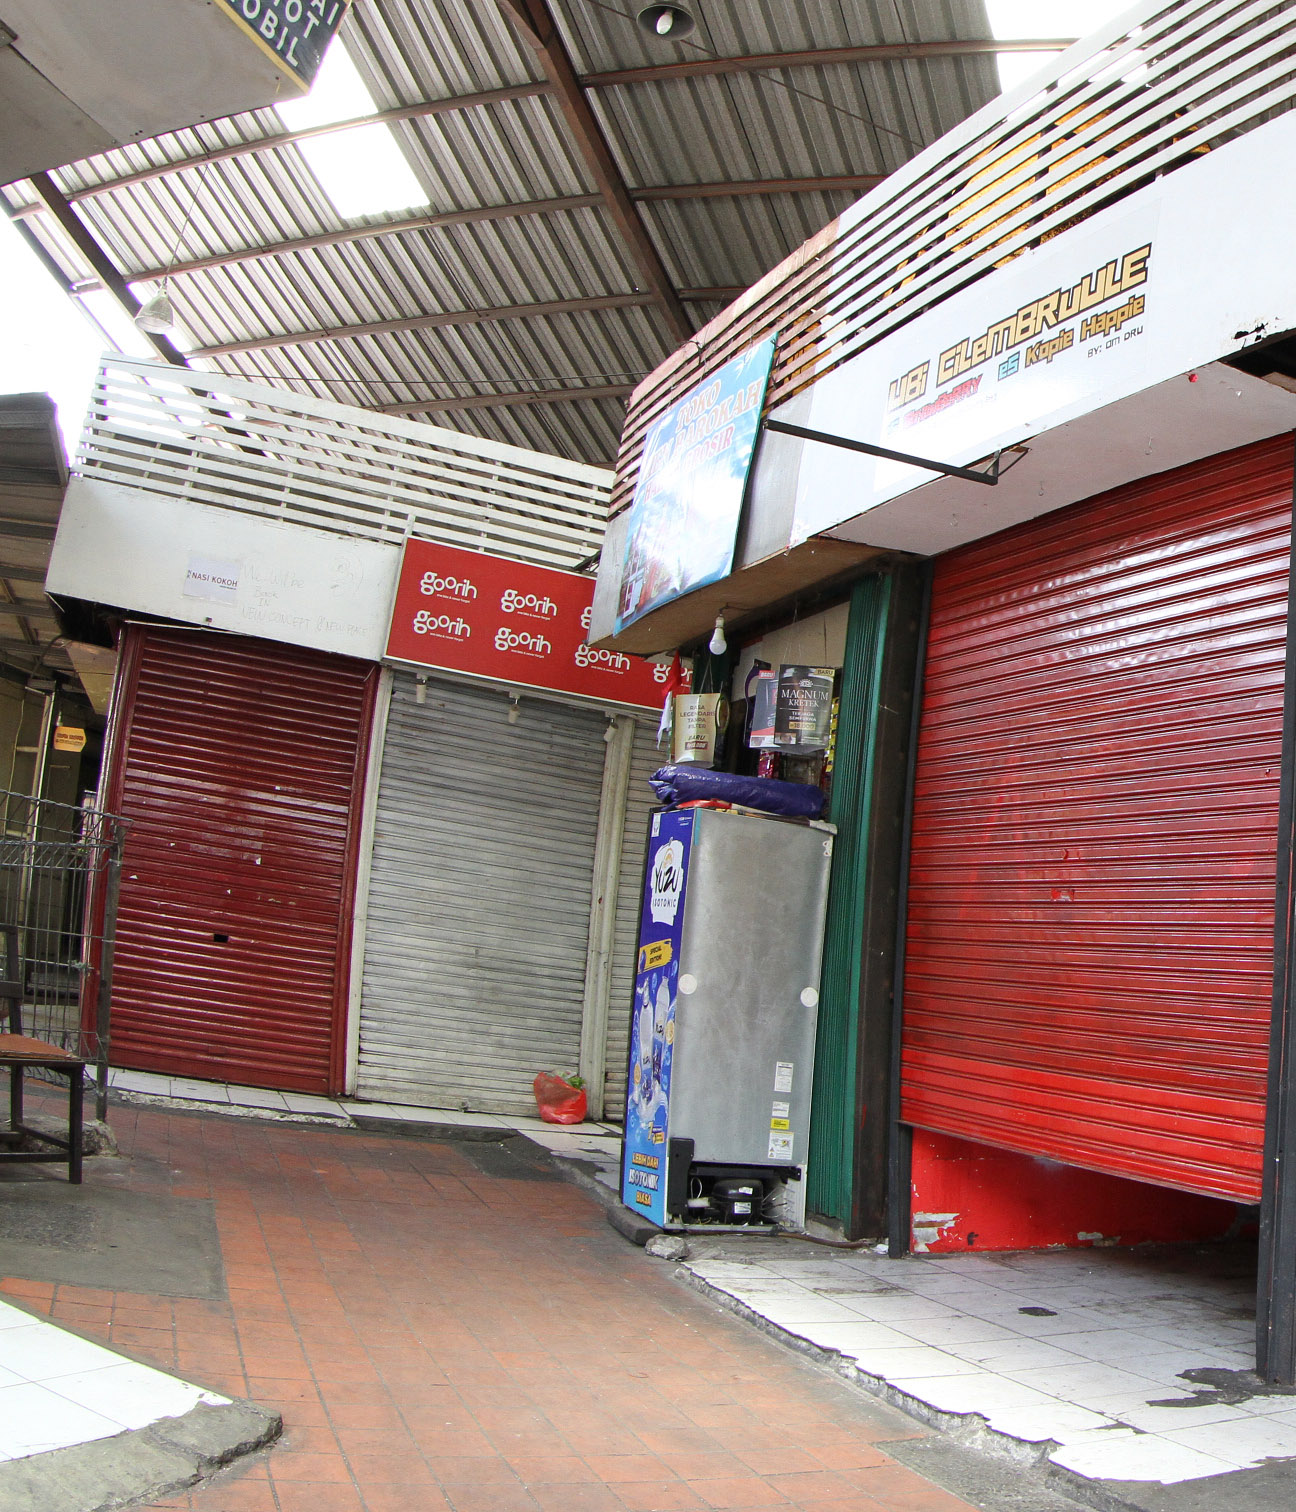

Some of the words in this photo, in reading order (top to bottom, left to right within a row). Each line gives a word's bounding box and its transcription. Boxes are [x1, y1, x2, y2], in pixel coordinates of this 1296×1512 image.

[274, 0, 320, 38] OT
[231, 0, 298, 67] OBIL
[192, 572, 210, 582] NASI
[212, 576, 238, 588] KOKOH
[420, 571, 478, 599] goorih
[501, 588, 558, 616] goorih
[413, 610, 471, 638] goorih
[494, 626, 552, 654] goorih
[574, 644, 630, 670] goorih
[781, 689, 829, 701] MAGNUM
[788, 698, 819, 708] KRETEK
[655, 866, 679, 894] YUZU
[652, 898, 676, 908] ISOTONIC
